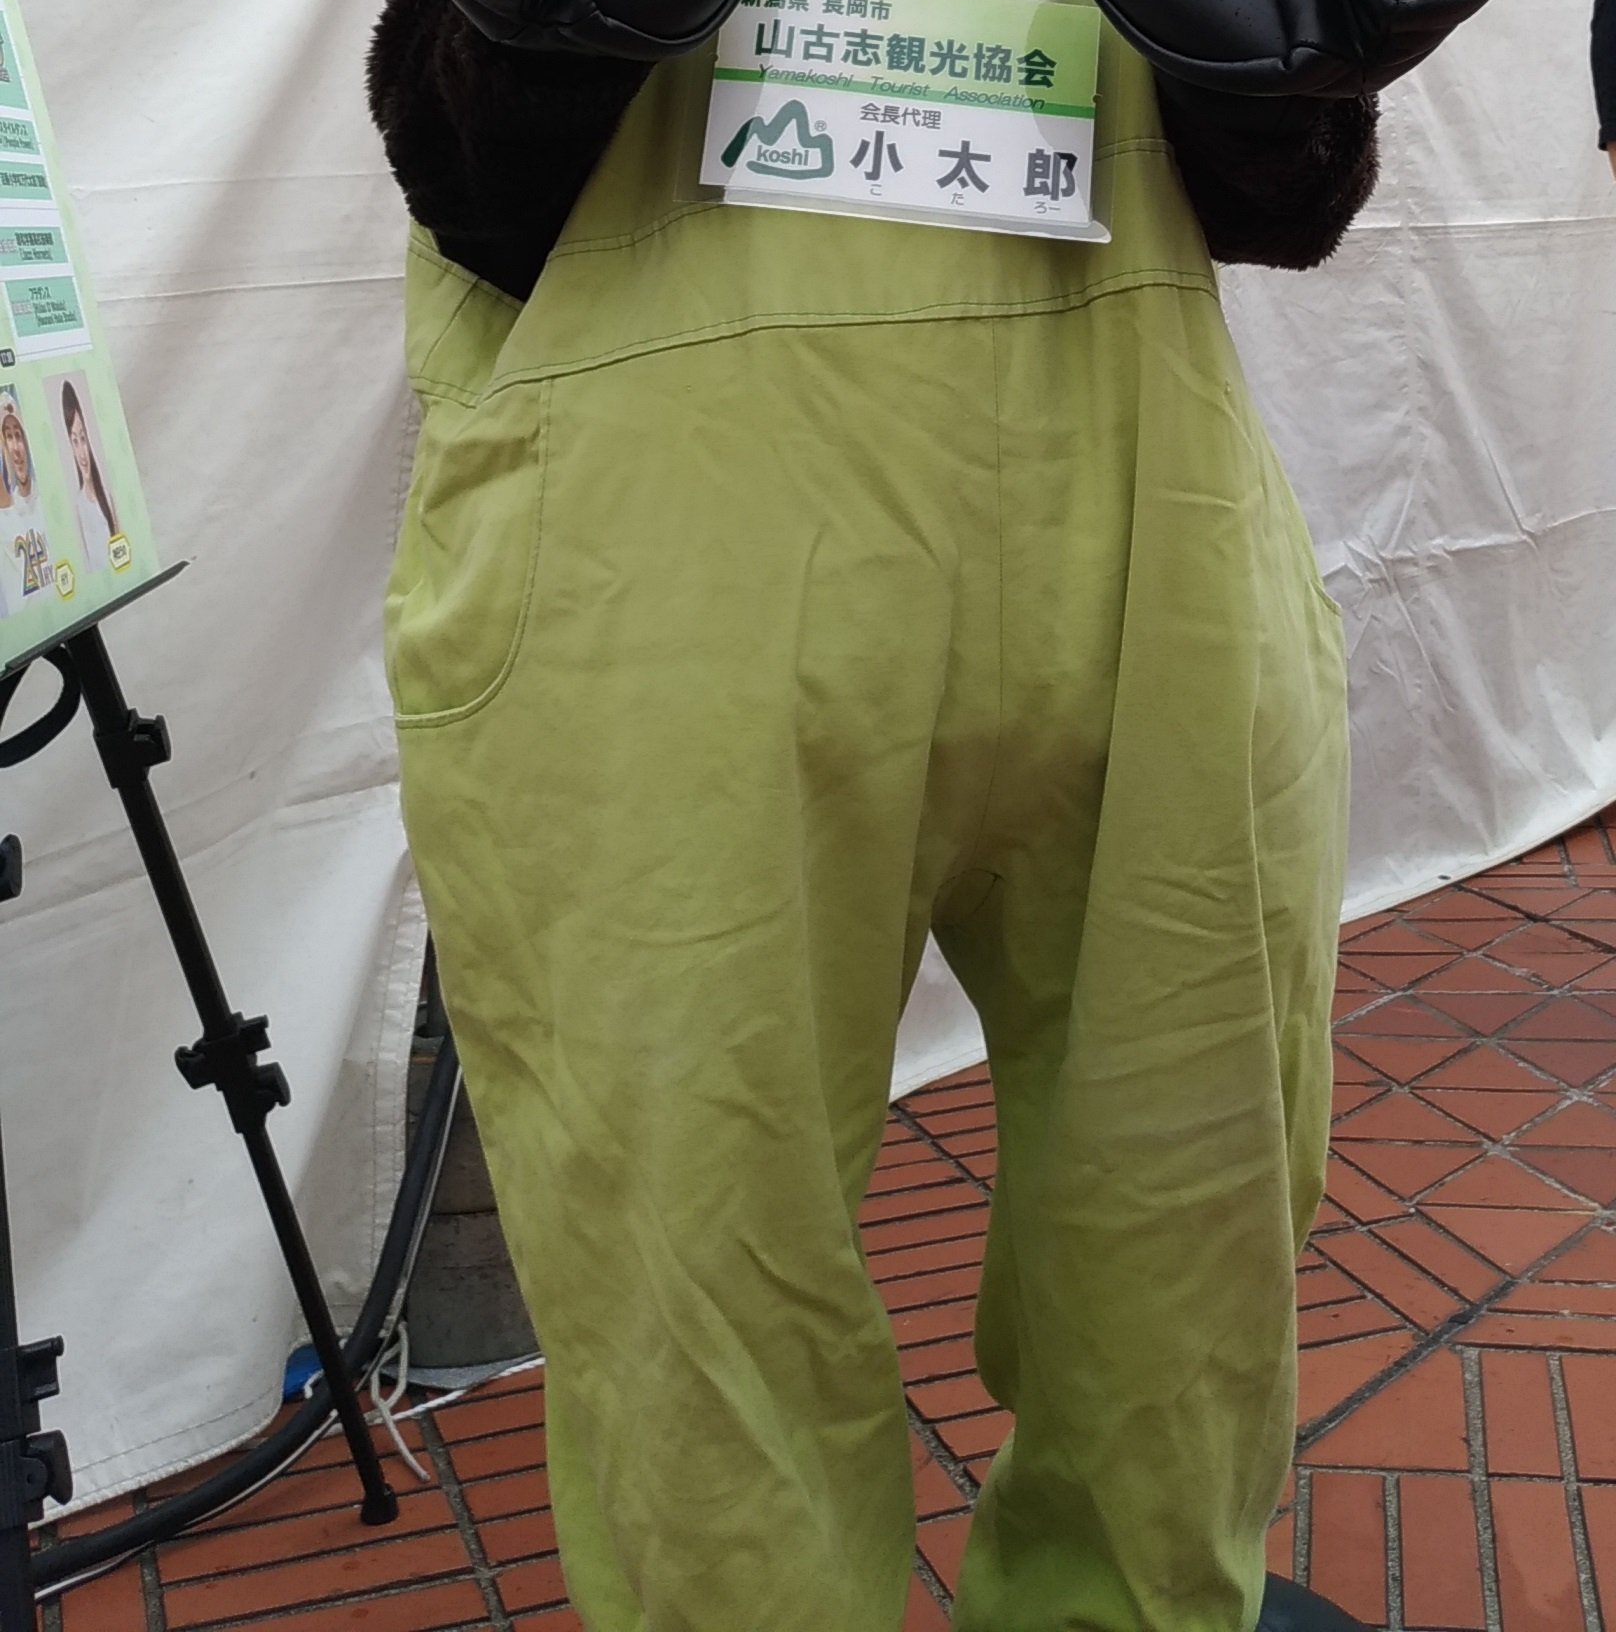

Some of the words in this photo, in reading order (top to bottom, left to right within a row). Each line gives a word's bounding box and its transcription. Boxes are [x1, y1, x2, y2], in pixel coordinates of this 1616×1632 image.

[755, 19, 1057, 88] 山古志観光協会
[758, 63, 853, 88] Yamakoshi
[870, 76, 931, 98] Tourist
[944, 86, 1045, 110] Association
[860, 102, 942, 130] 会長代理
[756, 145, 810, 166] koshi
